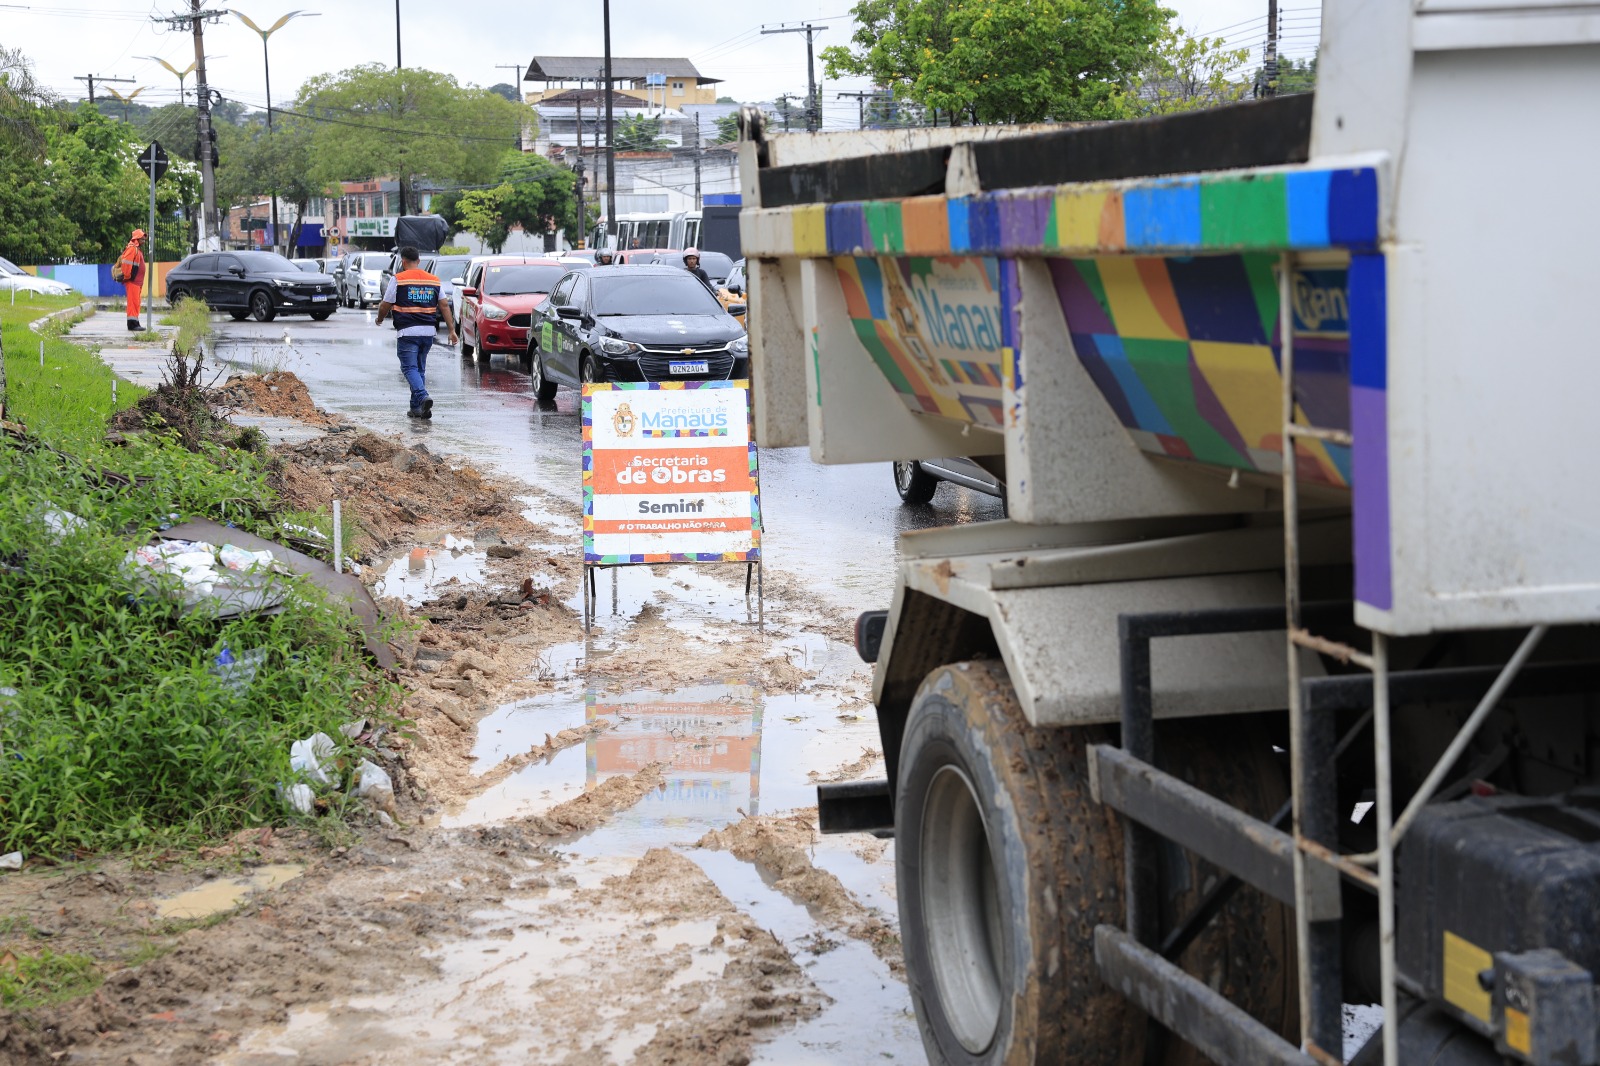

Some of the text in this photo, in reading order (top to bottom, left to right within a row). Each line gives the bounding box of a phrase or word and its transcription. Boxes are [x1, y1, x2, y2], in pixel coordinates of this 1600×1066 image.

[641, 411, 728, 428] Manaus
[633, 454, 708, 467] Secretaria
[616, 465, 726, 485] de Obras
[638, 499, 704, 514] Seminf
